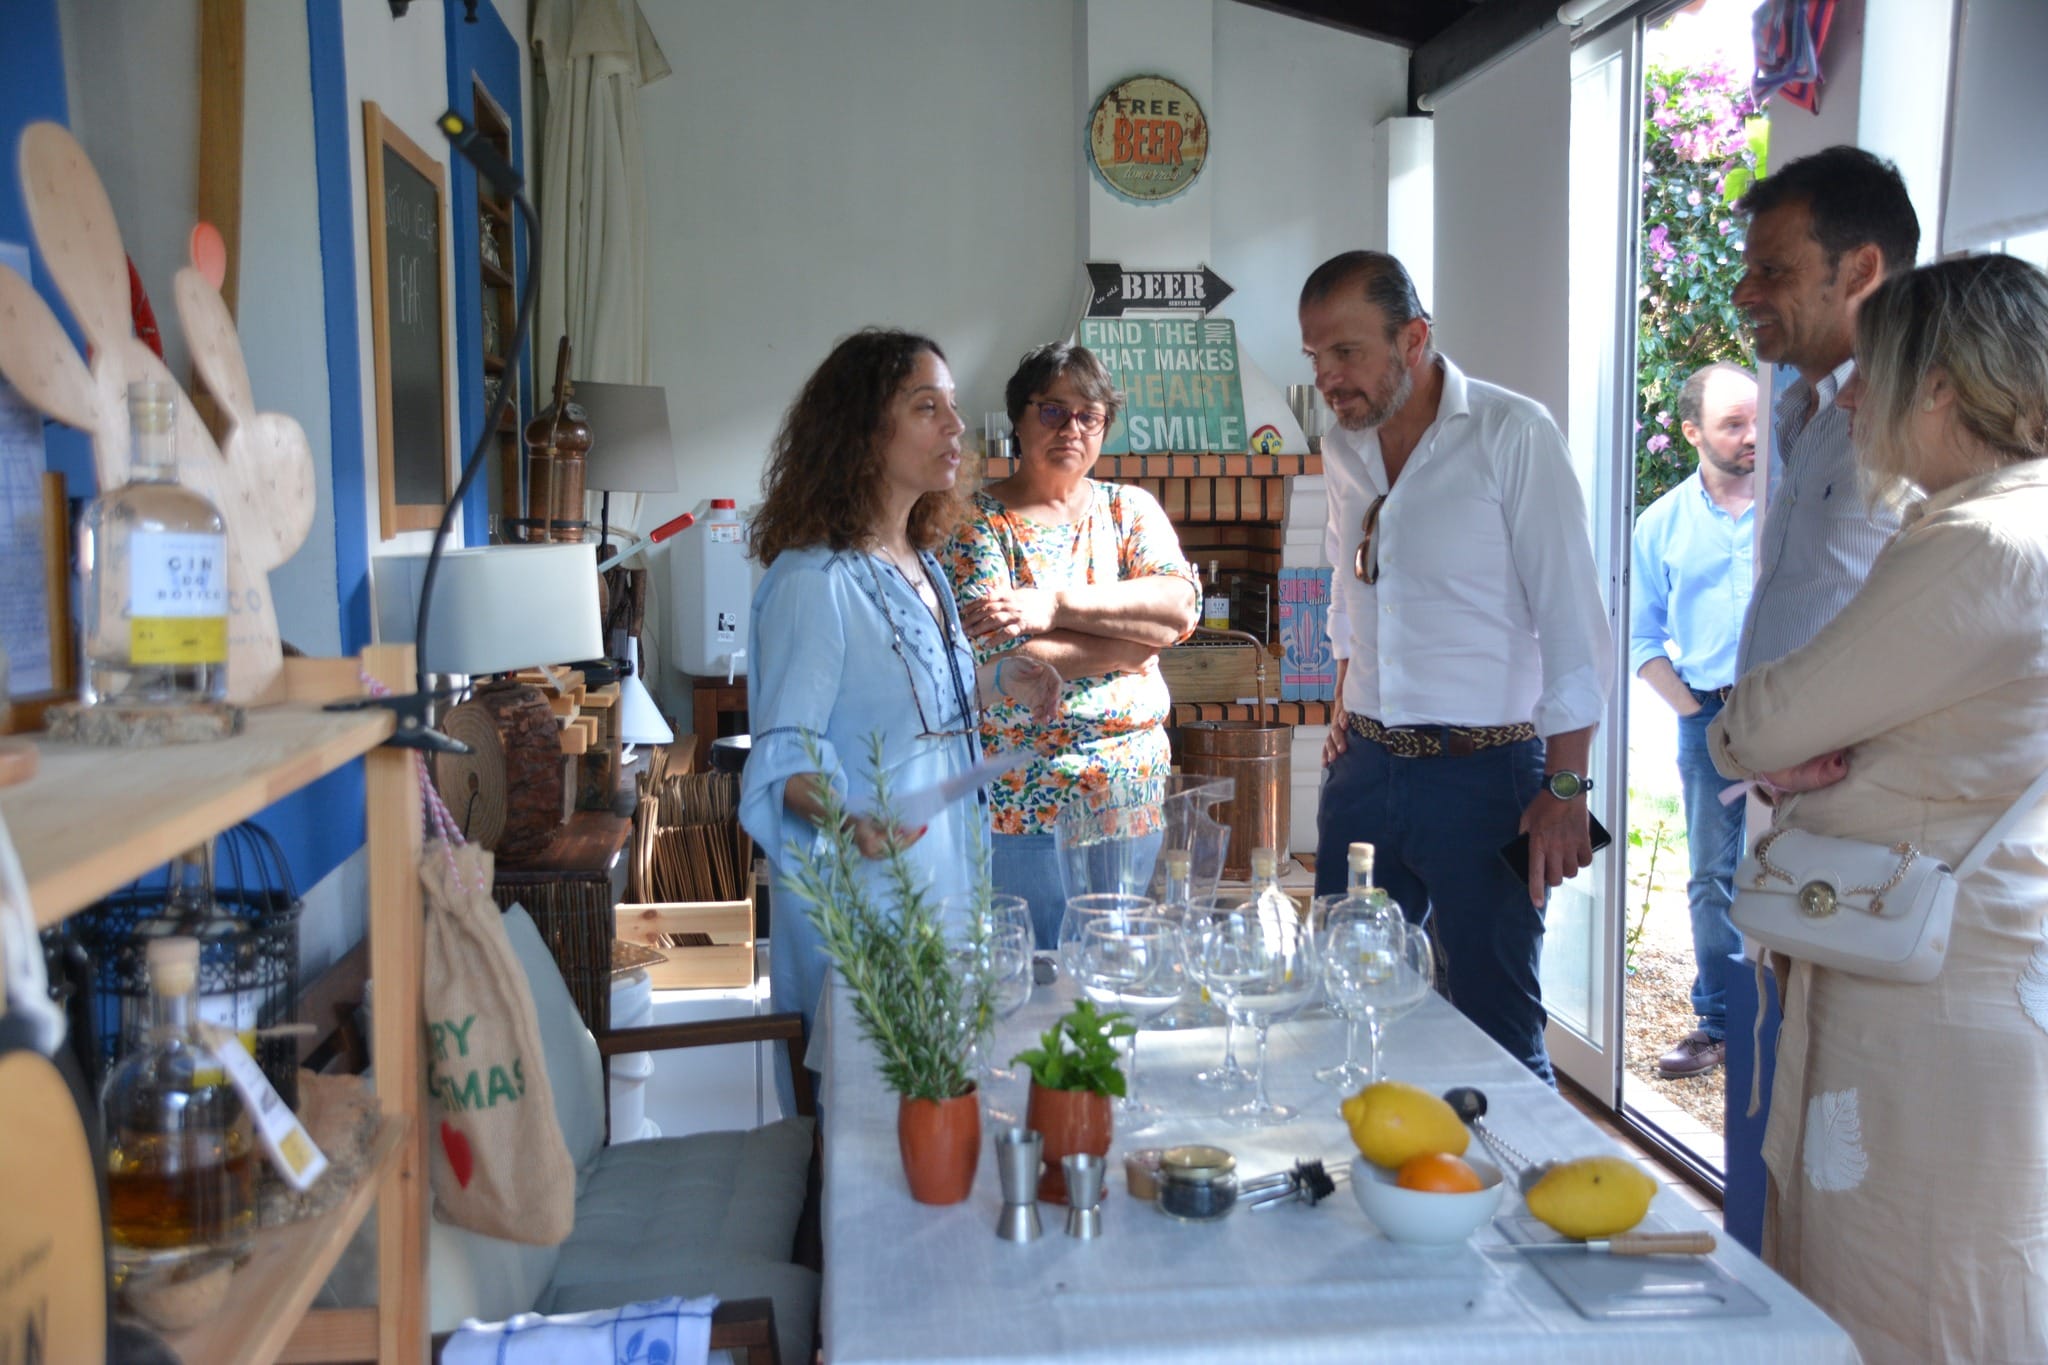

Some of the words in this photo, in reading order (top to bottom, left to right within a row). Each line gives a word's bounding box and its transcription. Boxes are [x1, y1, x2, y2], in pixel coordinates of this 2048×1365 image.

[1115, 98, 1181, 116] FREE
[1113, 117, 1184, 166] BEER
[1120, 273, 1207, 300] BEER
[1085, 322, 1142, 345] FIND
[1149, 322, 1197, 345] THE
[1204, 322, 1231, 345] ONE
[1154, 348, 1235, 371] MAKES
[1121, 373, 1236, 409] HEART
[1129, 415, 1241, 450] SMILE
[167, 557, 213, 571] GIN
[1279, 578, 1326, 604] SURFING
